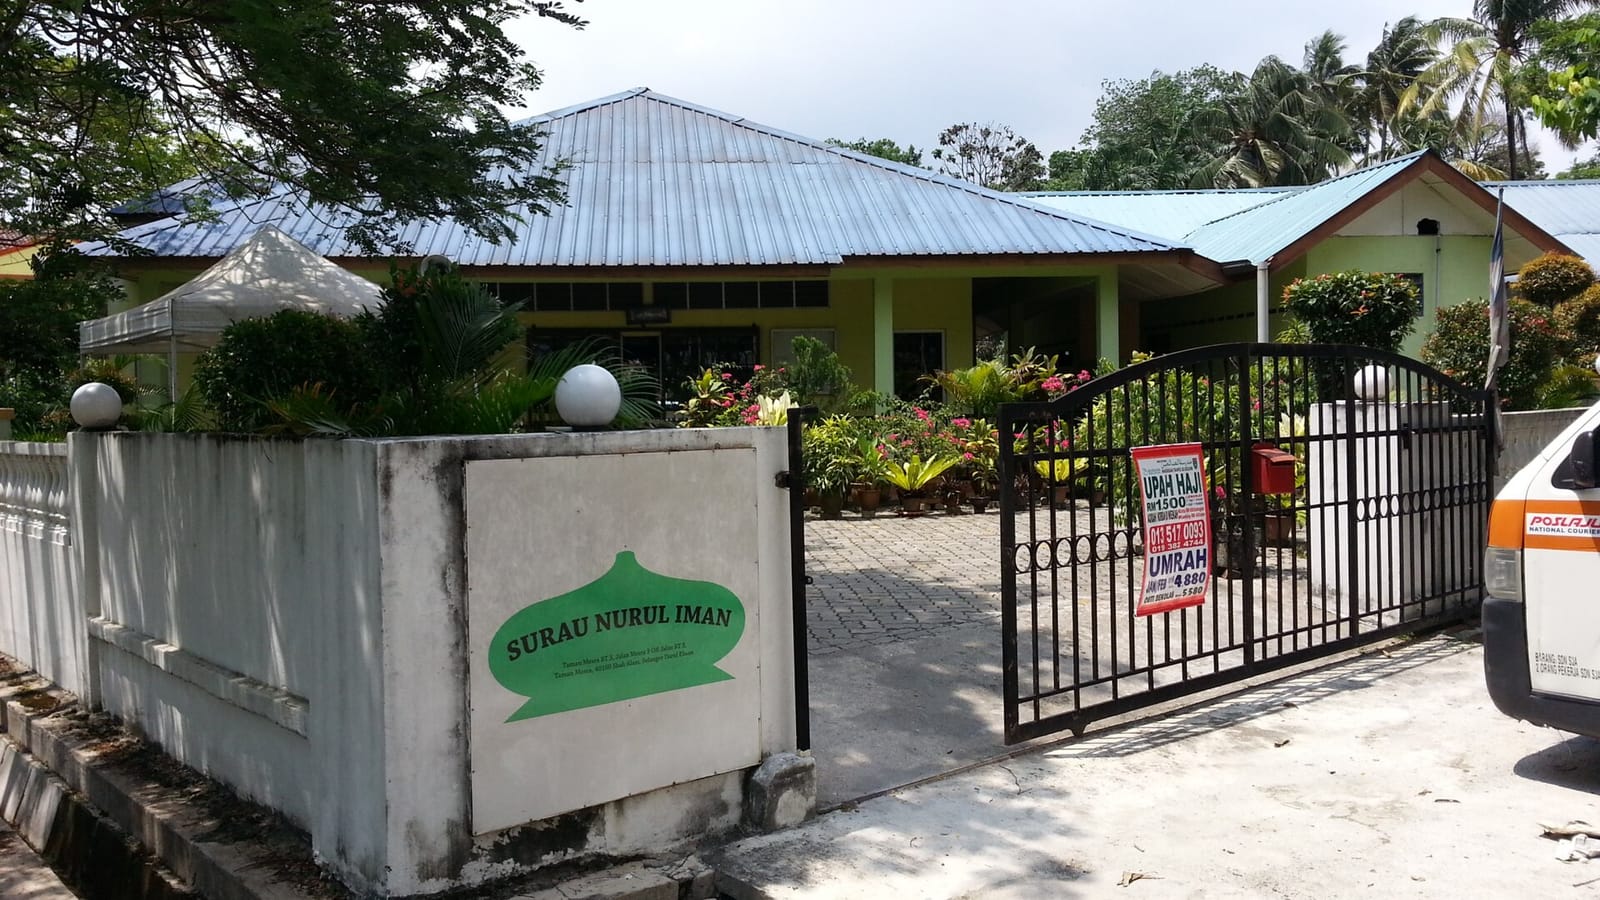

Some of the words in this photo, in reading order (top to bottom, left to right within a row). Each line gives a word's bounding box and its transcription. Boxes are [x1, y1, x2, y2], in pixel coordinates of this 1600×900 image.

[1144, 474, 1174, 499] UPAH
[1175, 472, 1202, 495] HAJI
[1150, 527, 1165, 545] 013
[1166, 524, 1181, 542] 517
[1183, 521, 1204, 540] 0093
[1149, 548, 1207, 577] UMRAH
[506, 616, 589, 661] SURAU
[595, 605, 670, 633] NURUL
[674, 605, 732, 628] IMAN
